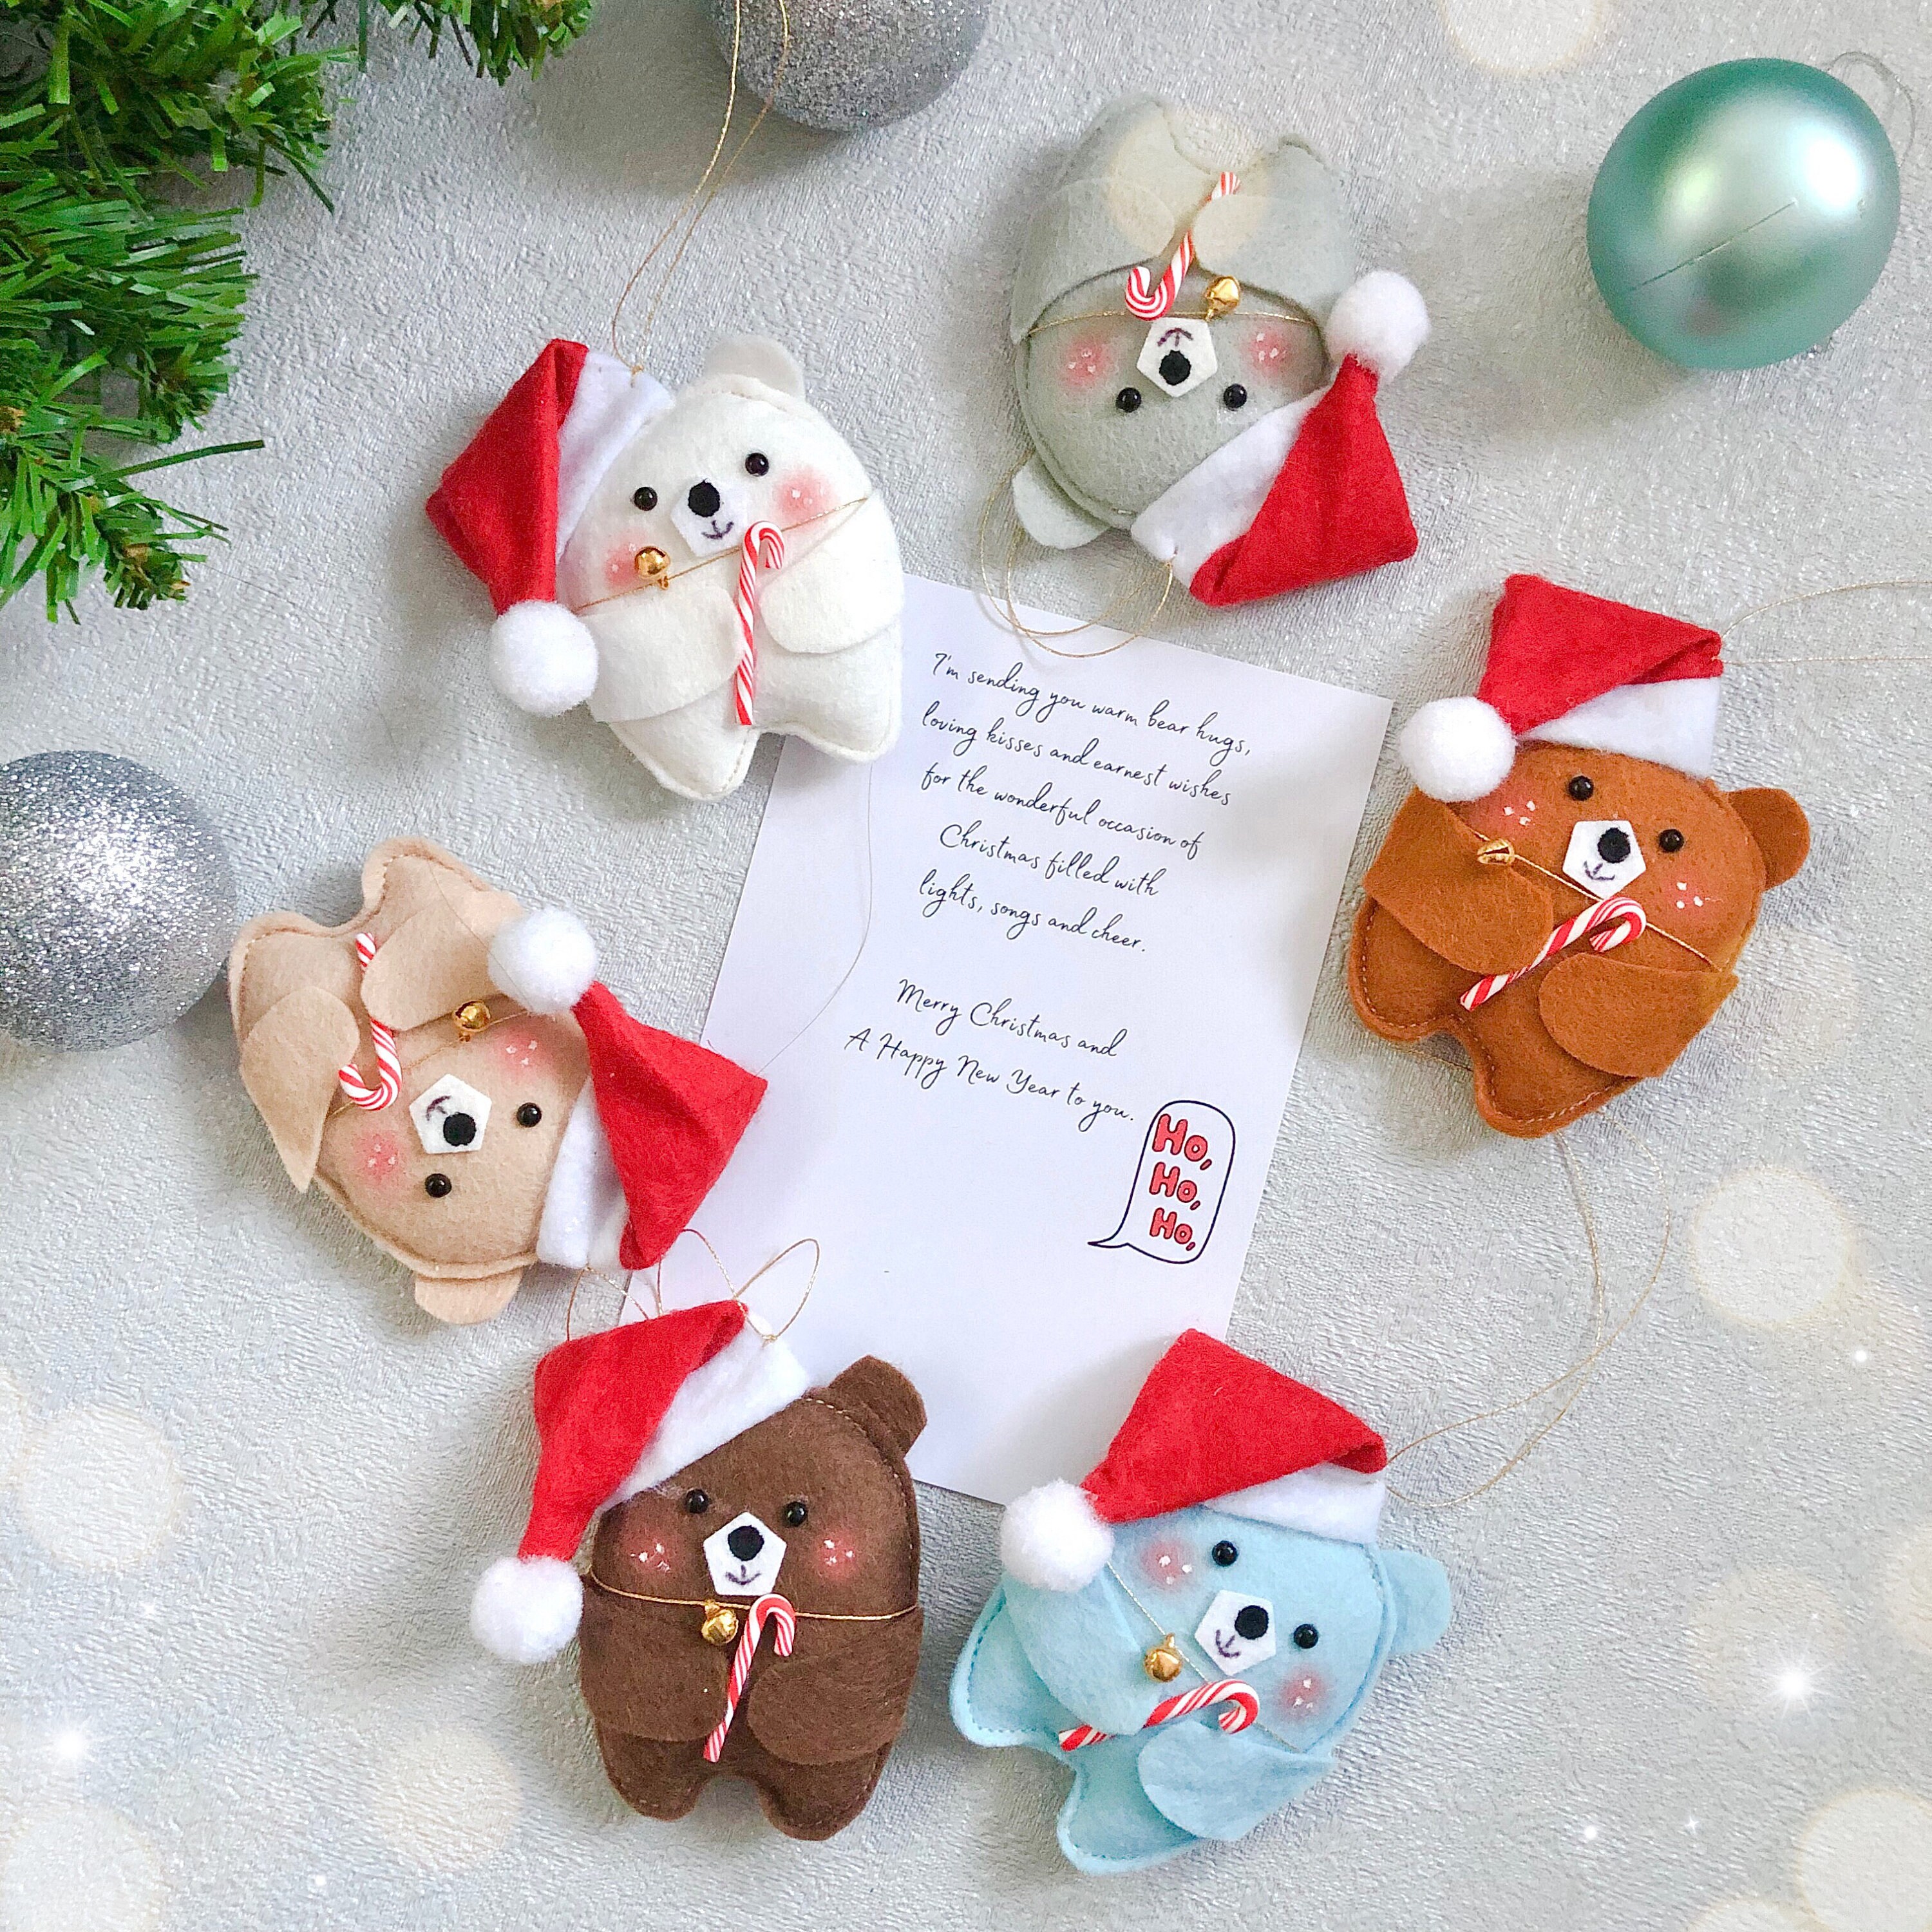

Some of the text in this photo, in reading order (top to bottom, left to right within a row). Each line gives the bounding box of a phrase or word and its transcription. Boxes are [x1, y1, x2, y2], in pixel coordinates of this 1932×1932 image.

[933, 652, 1251, 766] I'm sending you warm bear hugs,
[922, 701, 1229, 806] loving kisses and earnest wishes
[921, 762, 1206, 859] for the wonderful occasion of
[940, 820, 1167, 896] Christmas filled with
[920, 869, 1146, 952] lights, songs and cheer.
[897, 978, 1128, 1057] Merry Christmas and
[844, 1028, 1134, 1132] A Happy New Year to you.
[1151, 1113, 1212, 1171] Ho,
[1149, 1161, 1200, 1211] Ho,
[1149, 1207, 1196, 1251] Ho,
